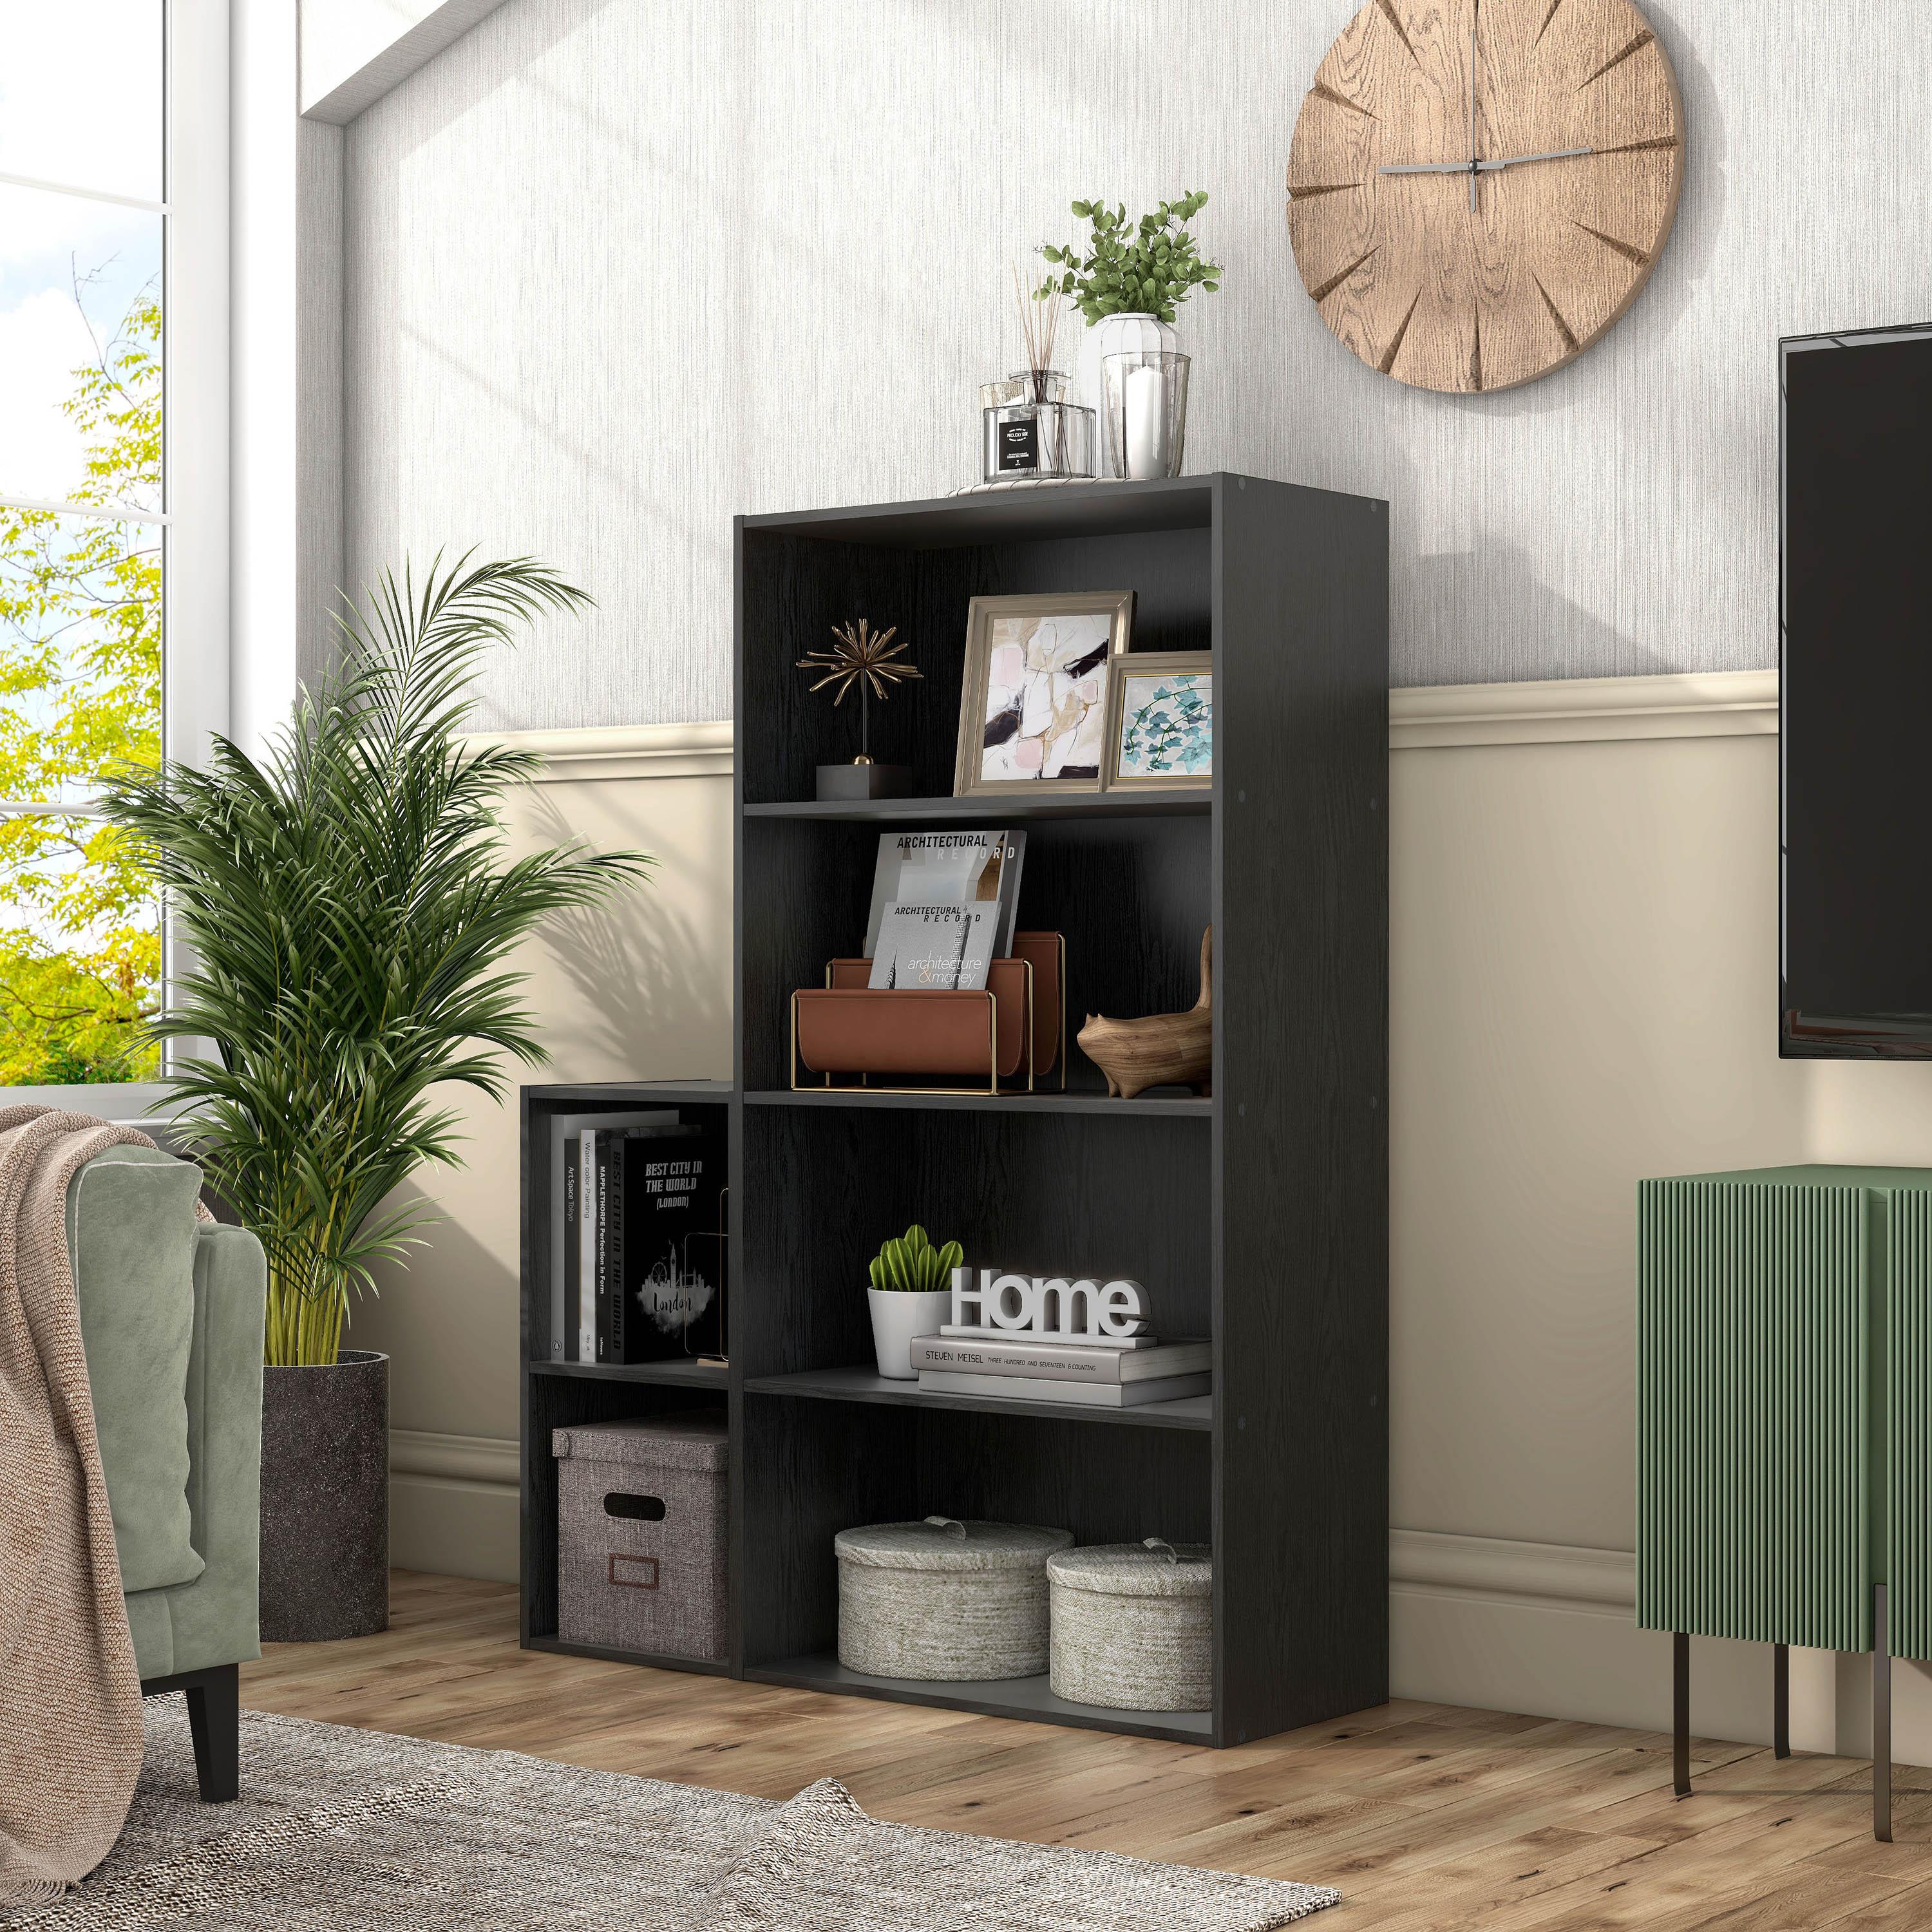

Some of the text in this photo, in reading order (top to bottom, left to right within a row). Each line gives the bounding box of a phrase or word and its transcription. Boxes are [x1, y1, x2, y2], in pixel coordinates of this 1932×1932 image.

[896, 835, 988, 849] ARCHITECTURAL
[895, 906, 961, 914] ARCHITECTURAL
[923, 914, 981, 922] RECORD
[907, 950, 982, 970] architecture
[645, 1162, 669, 1177] BEST
[670, 1160, 691, 1175] CITY
[645, 1177, 697, 1193] THE WORLD
[656, 1196, 690, 1211] (LONDON)
[654, 1291, 693, 1314] London
[951, 1267, 1152, 1337] Home
[925, 1350, 953, 1361] STEVEN
[958, 1354, 984, 1363] MEISEL
